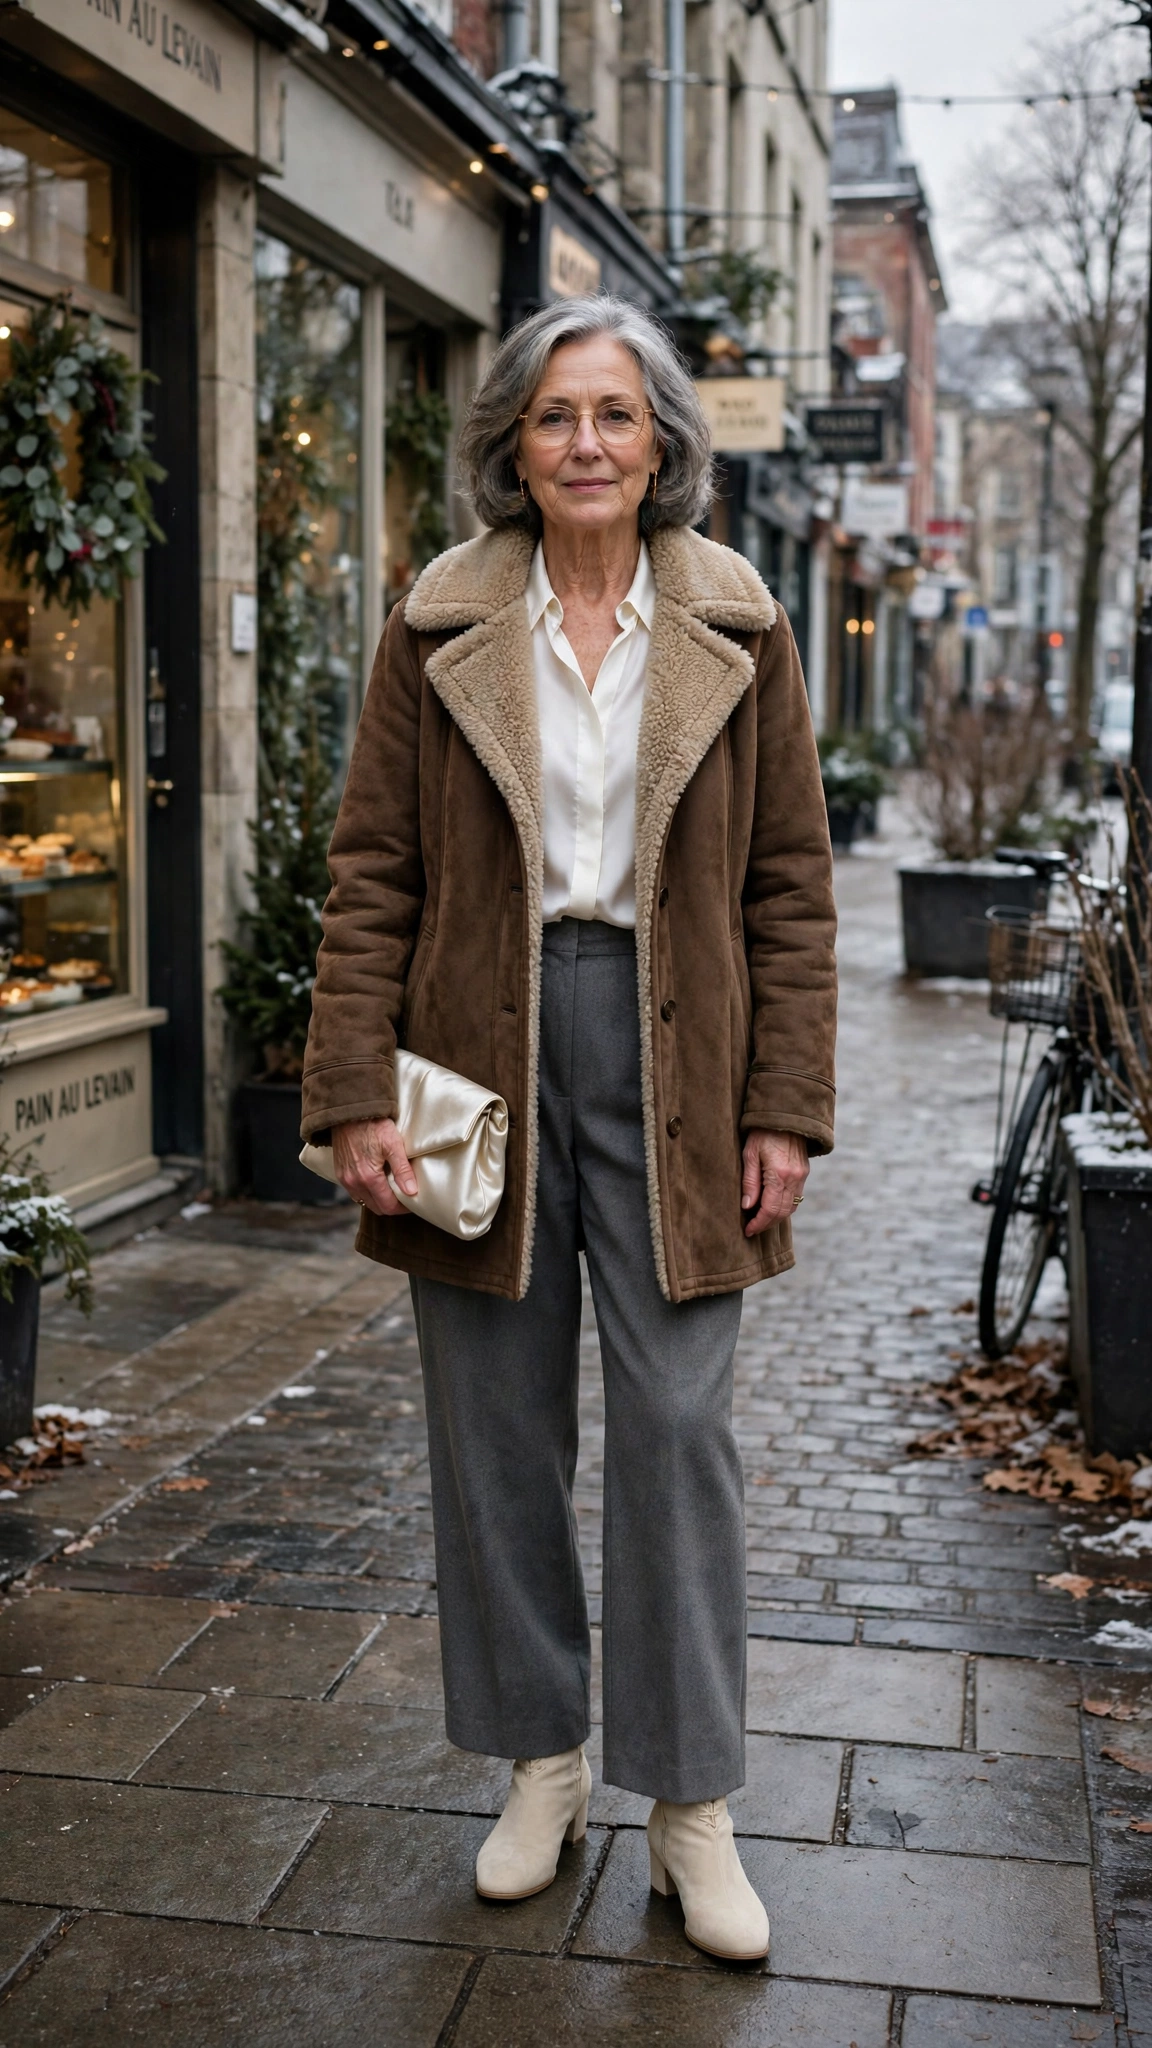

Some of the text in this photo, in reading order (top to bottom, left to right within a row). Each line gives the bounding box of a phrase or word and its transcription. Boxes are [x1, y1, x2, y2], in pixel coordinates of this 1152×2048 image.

[128, 0, 156, 46] AU
[15, 1065, 136, 1131] PAIN AU LEVAIN
